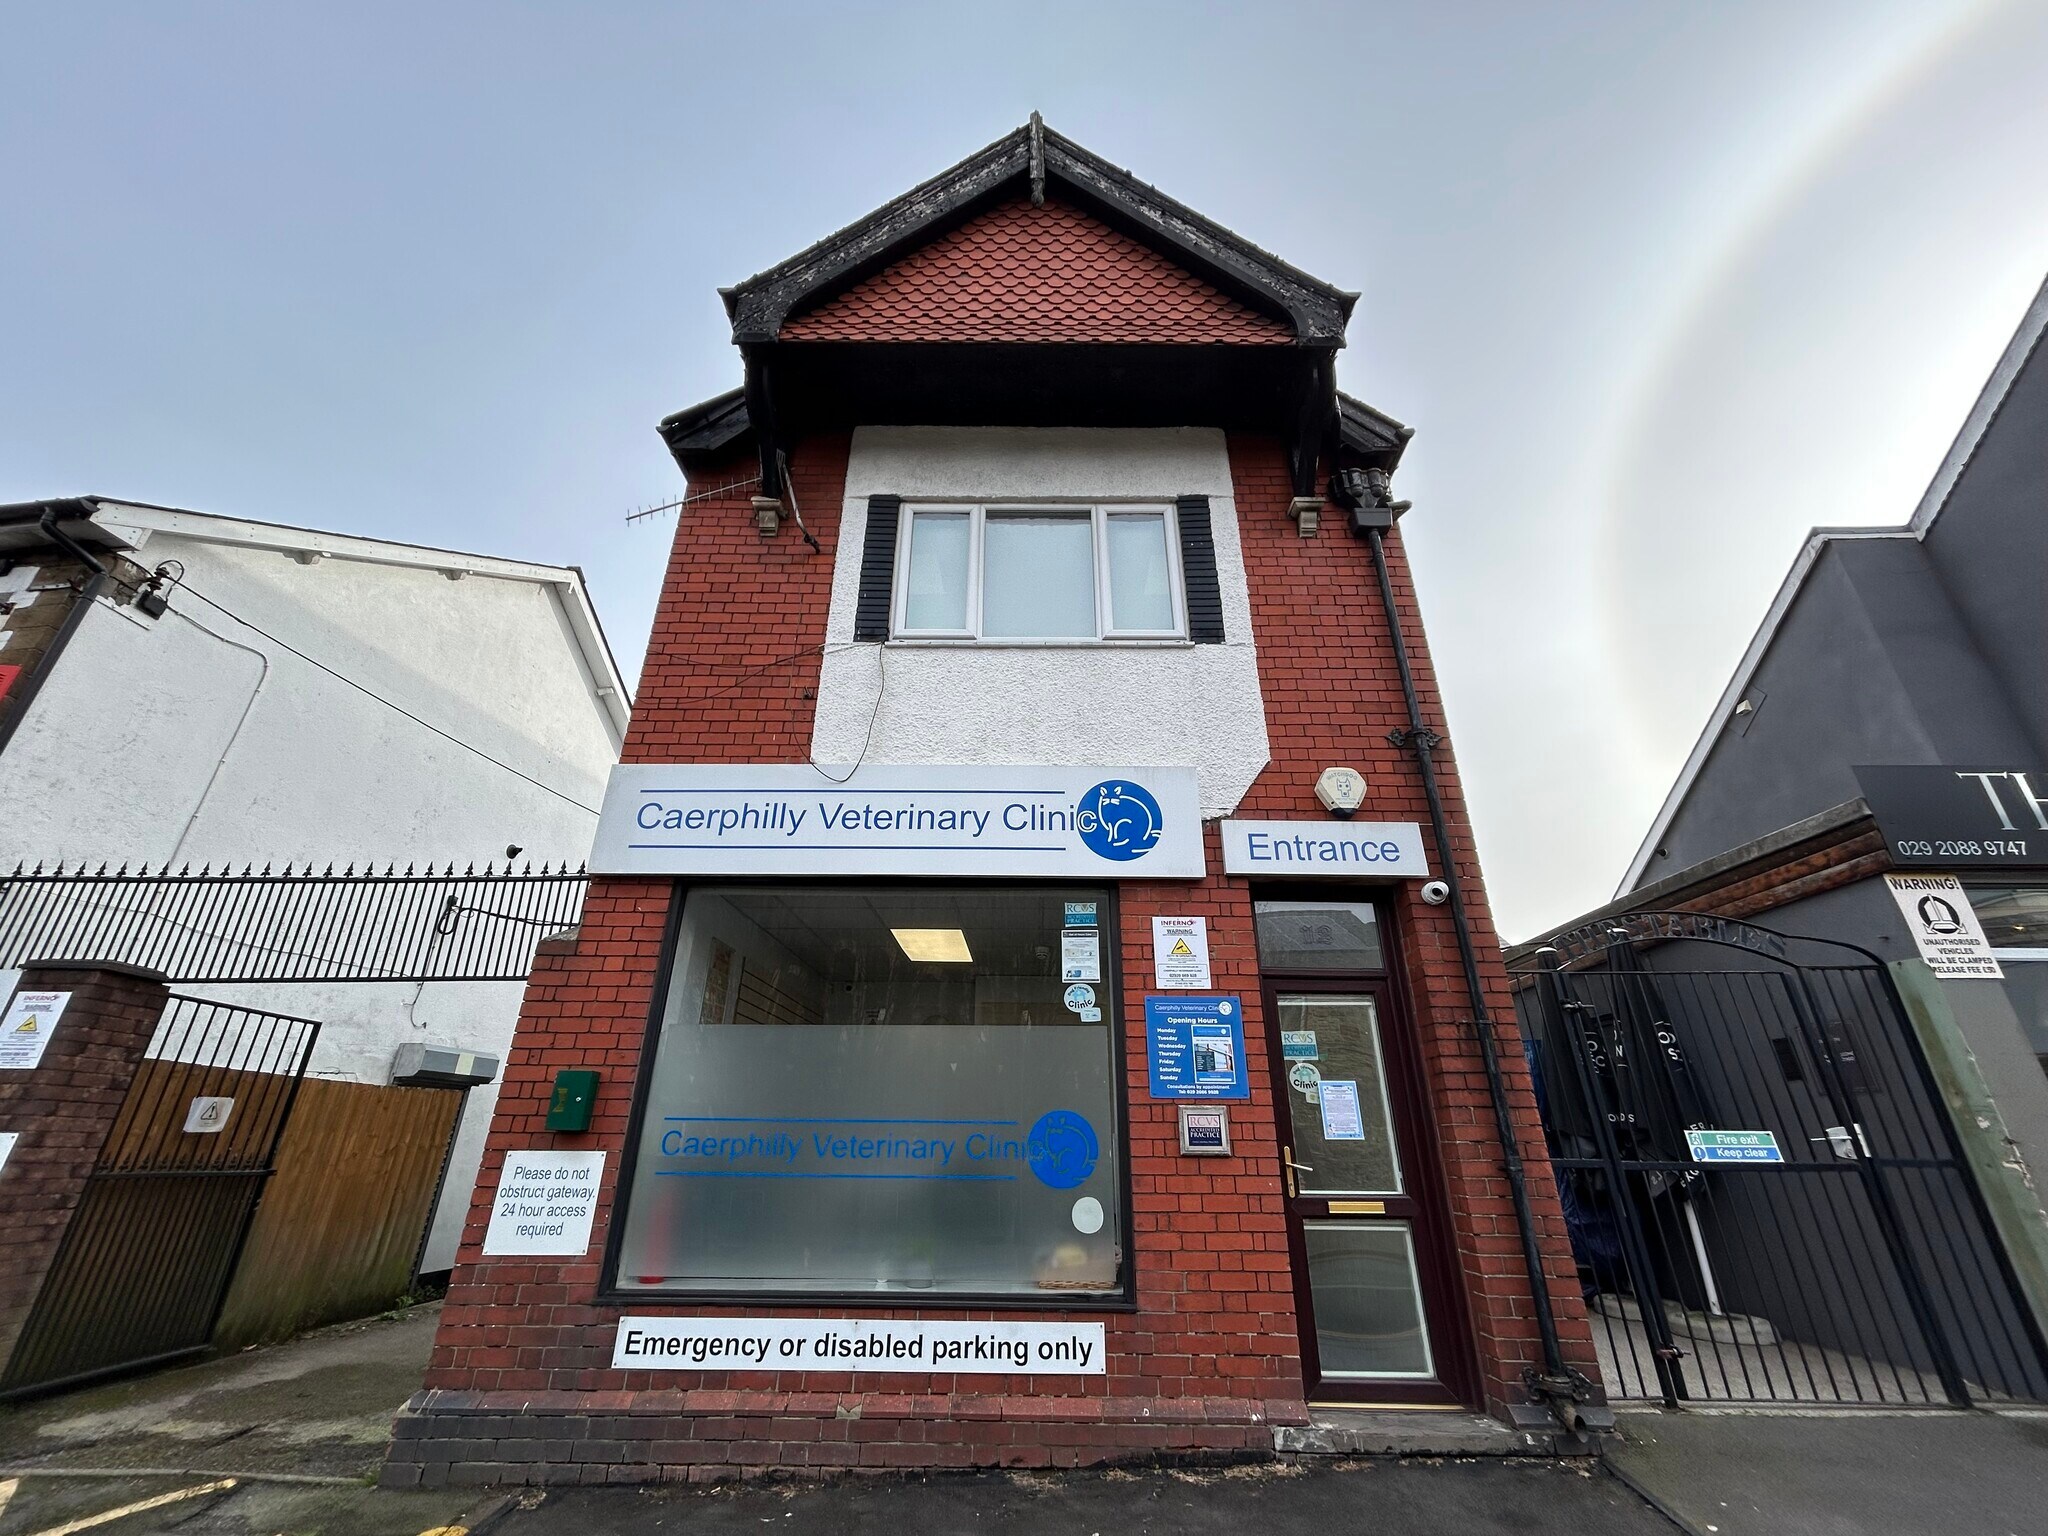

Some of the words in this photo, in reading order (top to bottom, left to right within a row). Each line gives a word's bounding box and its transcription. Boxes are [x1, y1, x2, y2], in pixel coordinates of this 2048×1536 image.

[636, 802, 806, 838] Caerphilly
[818, 803, 990, 838] Veterinary
[1002, 804, 1098, 832] Clinic
[1247, 833, 1401, 862] Entrance
[1898, 841, 1932, 856] 029
[1935, 841, 1982, 856] 2088
[1984, 841, 2027, 856] 9747
[1889, 878, 1960, 890] WARNING!
[1066, 904, 1095, 912] RCVS
[1068, 999, 1093, 1008] Clinic
[1284, 1033, 1313, 1043] RCVS
[1293, 1079, 1318, 1089] Clinic
[1189, 1117, 1219, 1126] RCVS
[1716, 1135, 1738, 1144] Fire
[1740, 1135, 1760, 1144] exit
[661, 1130, 802, 1164] Caerphilly
[813, 1132, 955, 1166] Veterinary
[1717, 1148, 1742, 1158] Keep
[1744, 1149, 1768, 1157] clear
[513, 1166, 552, 1180] Please
[554, 1166, 569, 1180] do
[571, 1167, 590, 1180] not
[500, 1184, 545, 1198] obstruct
[546, 1185, 595, 1202] gateway.
[500, 1202, 516, 1217] 24
[518, 1203, 545, 1217] hour
[546, 1206, 587, 1217] access
[515, 1222, 564, 1239] required
[624, 1331, 771, 1363] Emergency
[778, 1336, 808, 1357] or
[814, 1333, 924, 1359] disabled
[932, 1335, 1029, 1366] parking
[1037, 1336, 1093, 1366] only
